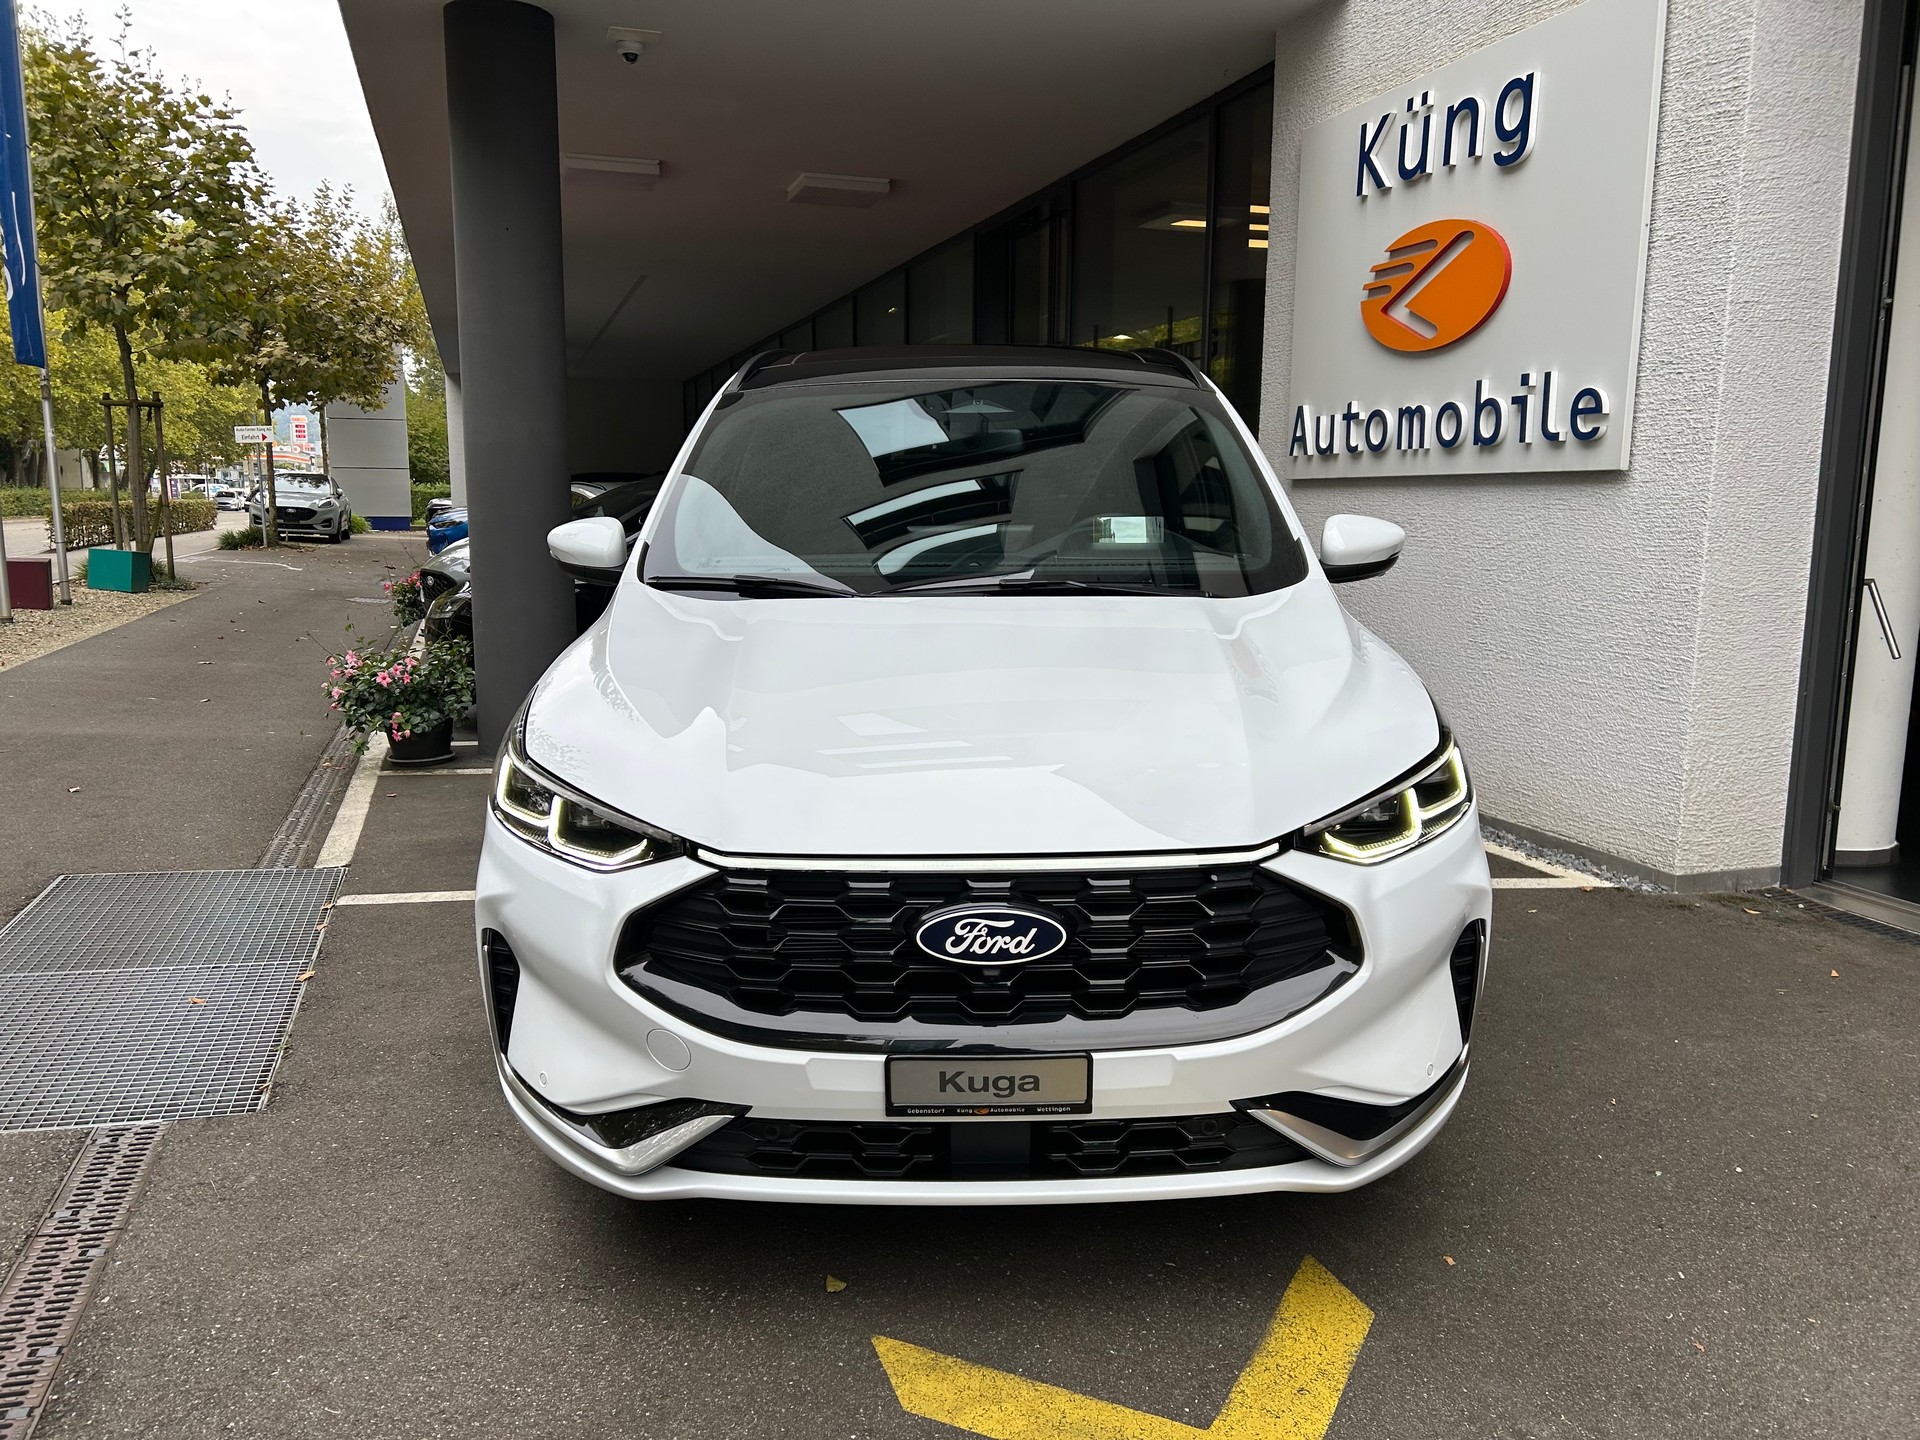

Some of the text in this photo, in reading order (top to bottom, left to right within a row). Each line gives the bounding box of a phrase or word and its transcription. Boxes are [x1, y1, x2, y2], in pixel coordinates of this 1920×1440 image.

[1356, 71, 1541, 197] Küng
[1289, 371, 1610, 457] Automobile
[945, 918, 1038, 954] Ford
[938, 1070, 1041, 1098] Kuga
